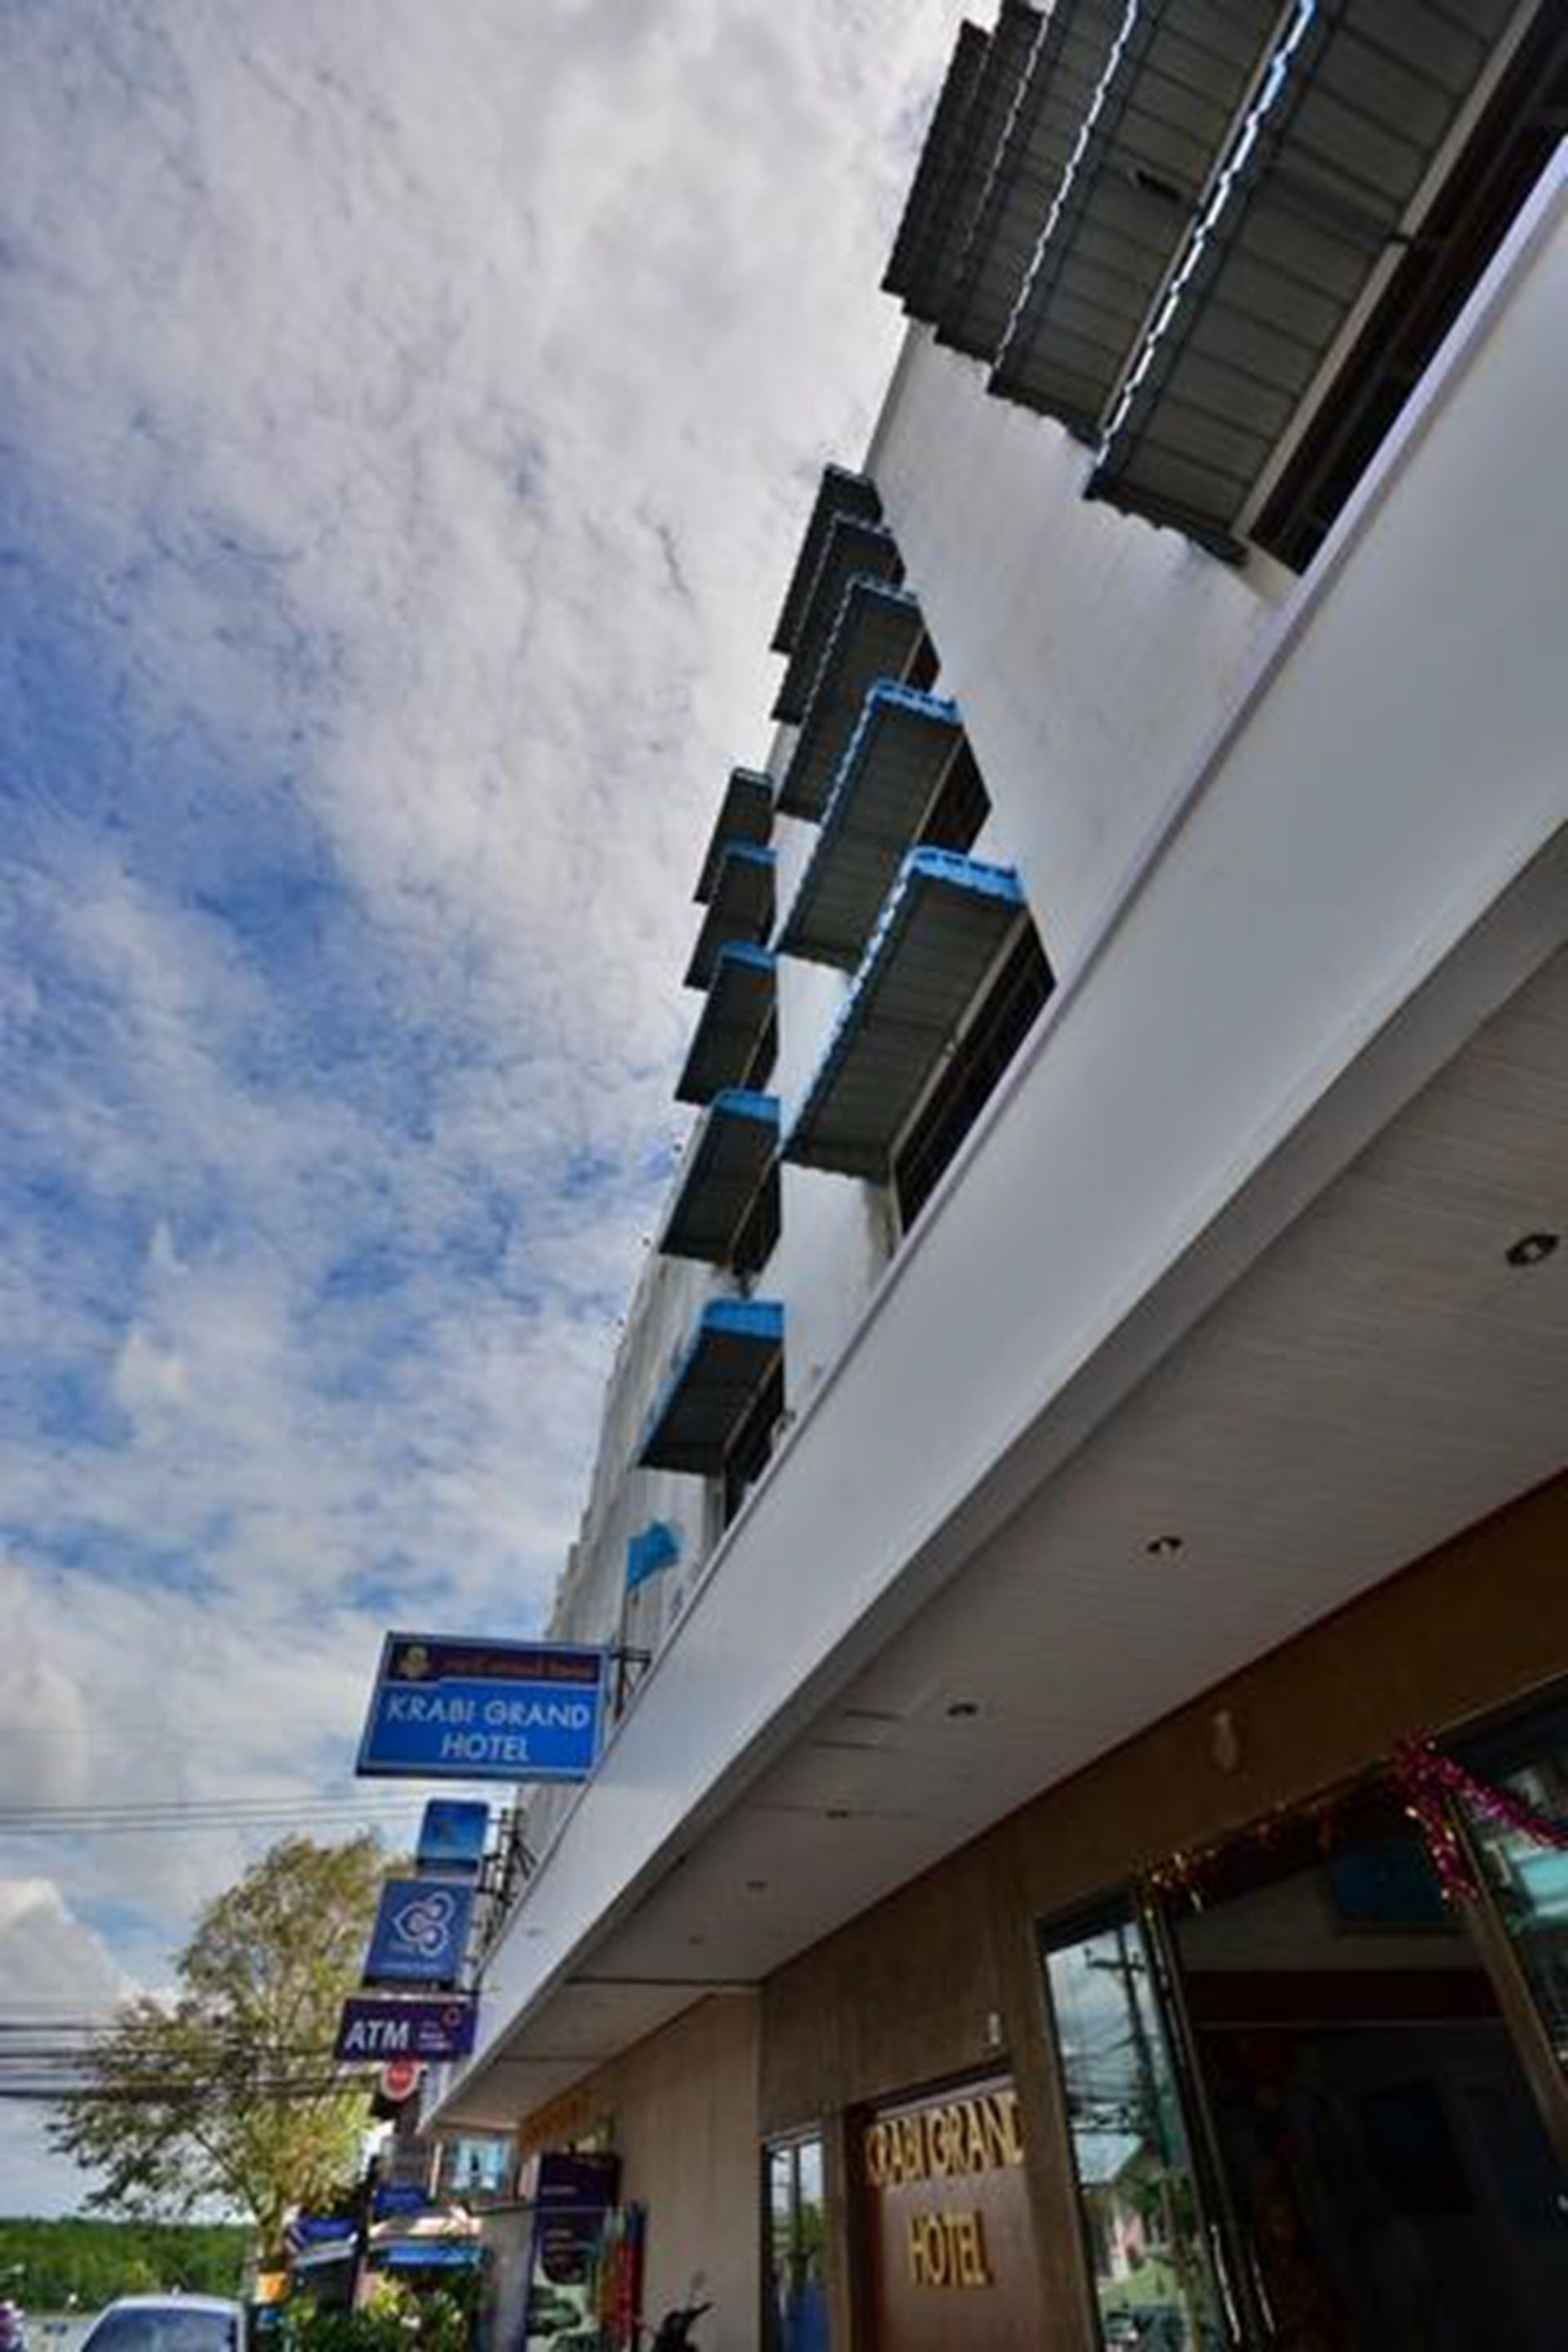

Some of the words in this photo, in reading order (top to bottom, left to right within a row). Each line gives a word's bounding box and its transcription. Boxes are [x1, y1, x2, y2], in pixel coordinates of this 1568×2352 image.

[385, 1693, 477, 1725] KRABI
[483, 1699, 591, 1731] GRAND
[439, 1731, 529, 1762] HOTEL
[344, 2019, 411, 2051] ATM
[910, 2211, 988, 2289] HOTEL
